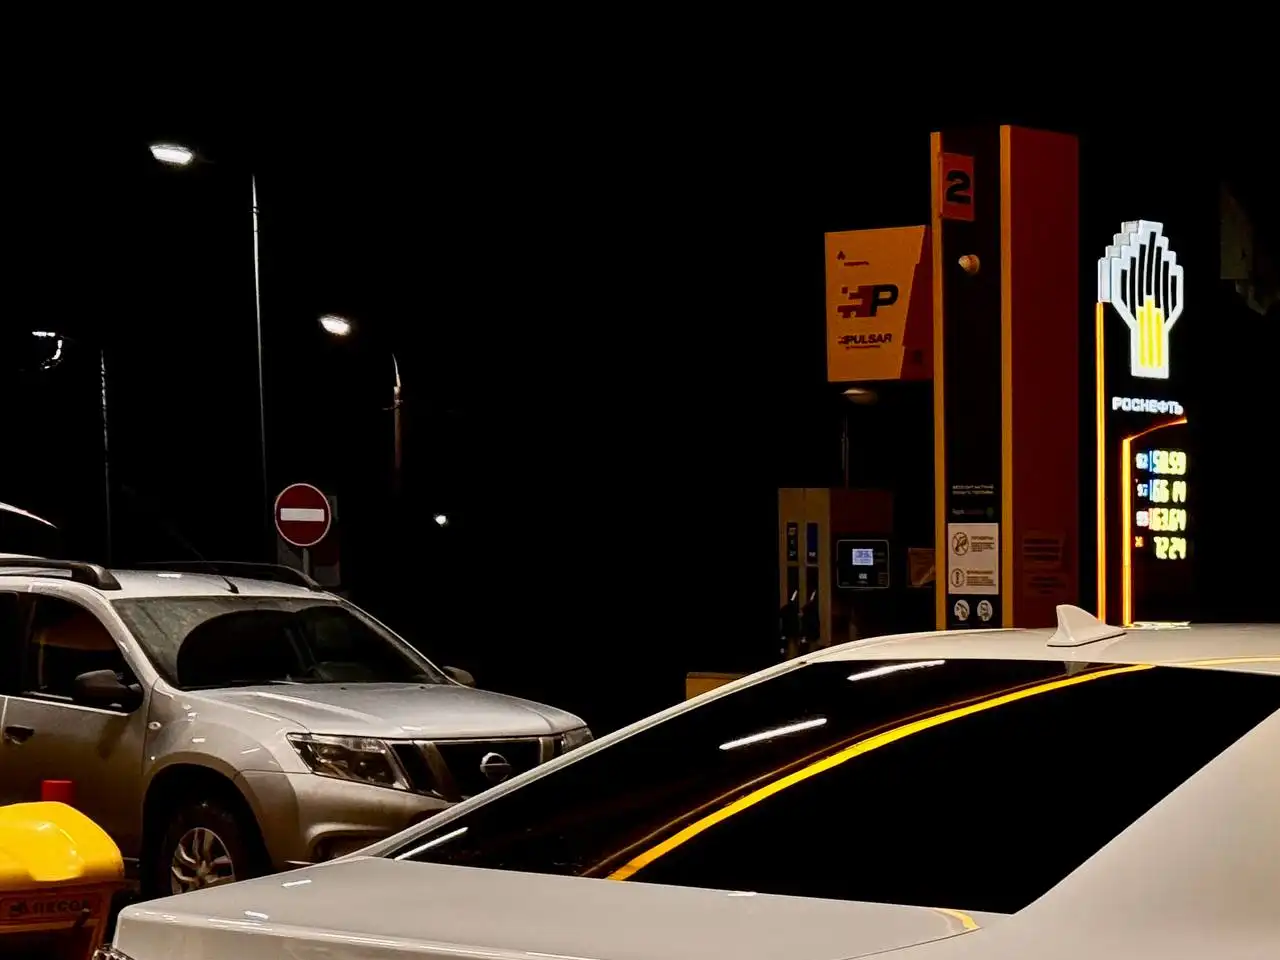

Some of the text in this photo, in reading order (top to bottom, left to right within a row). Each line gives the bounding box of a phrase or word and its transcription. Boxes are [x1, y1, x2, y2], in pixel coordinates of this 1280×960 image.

[945, 169, 971, 204] 2
[847, 333, 893, 345] PULSAR
[1112, 396, 1184, 416] РОСНЕФТЬ
